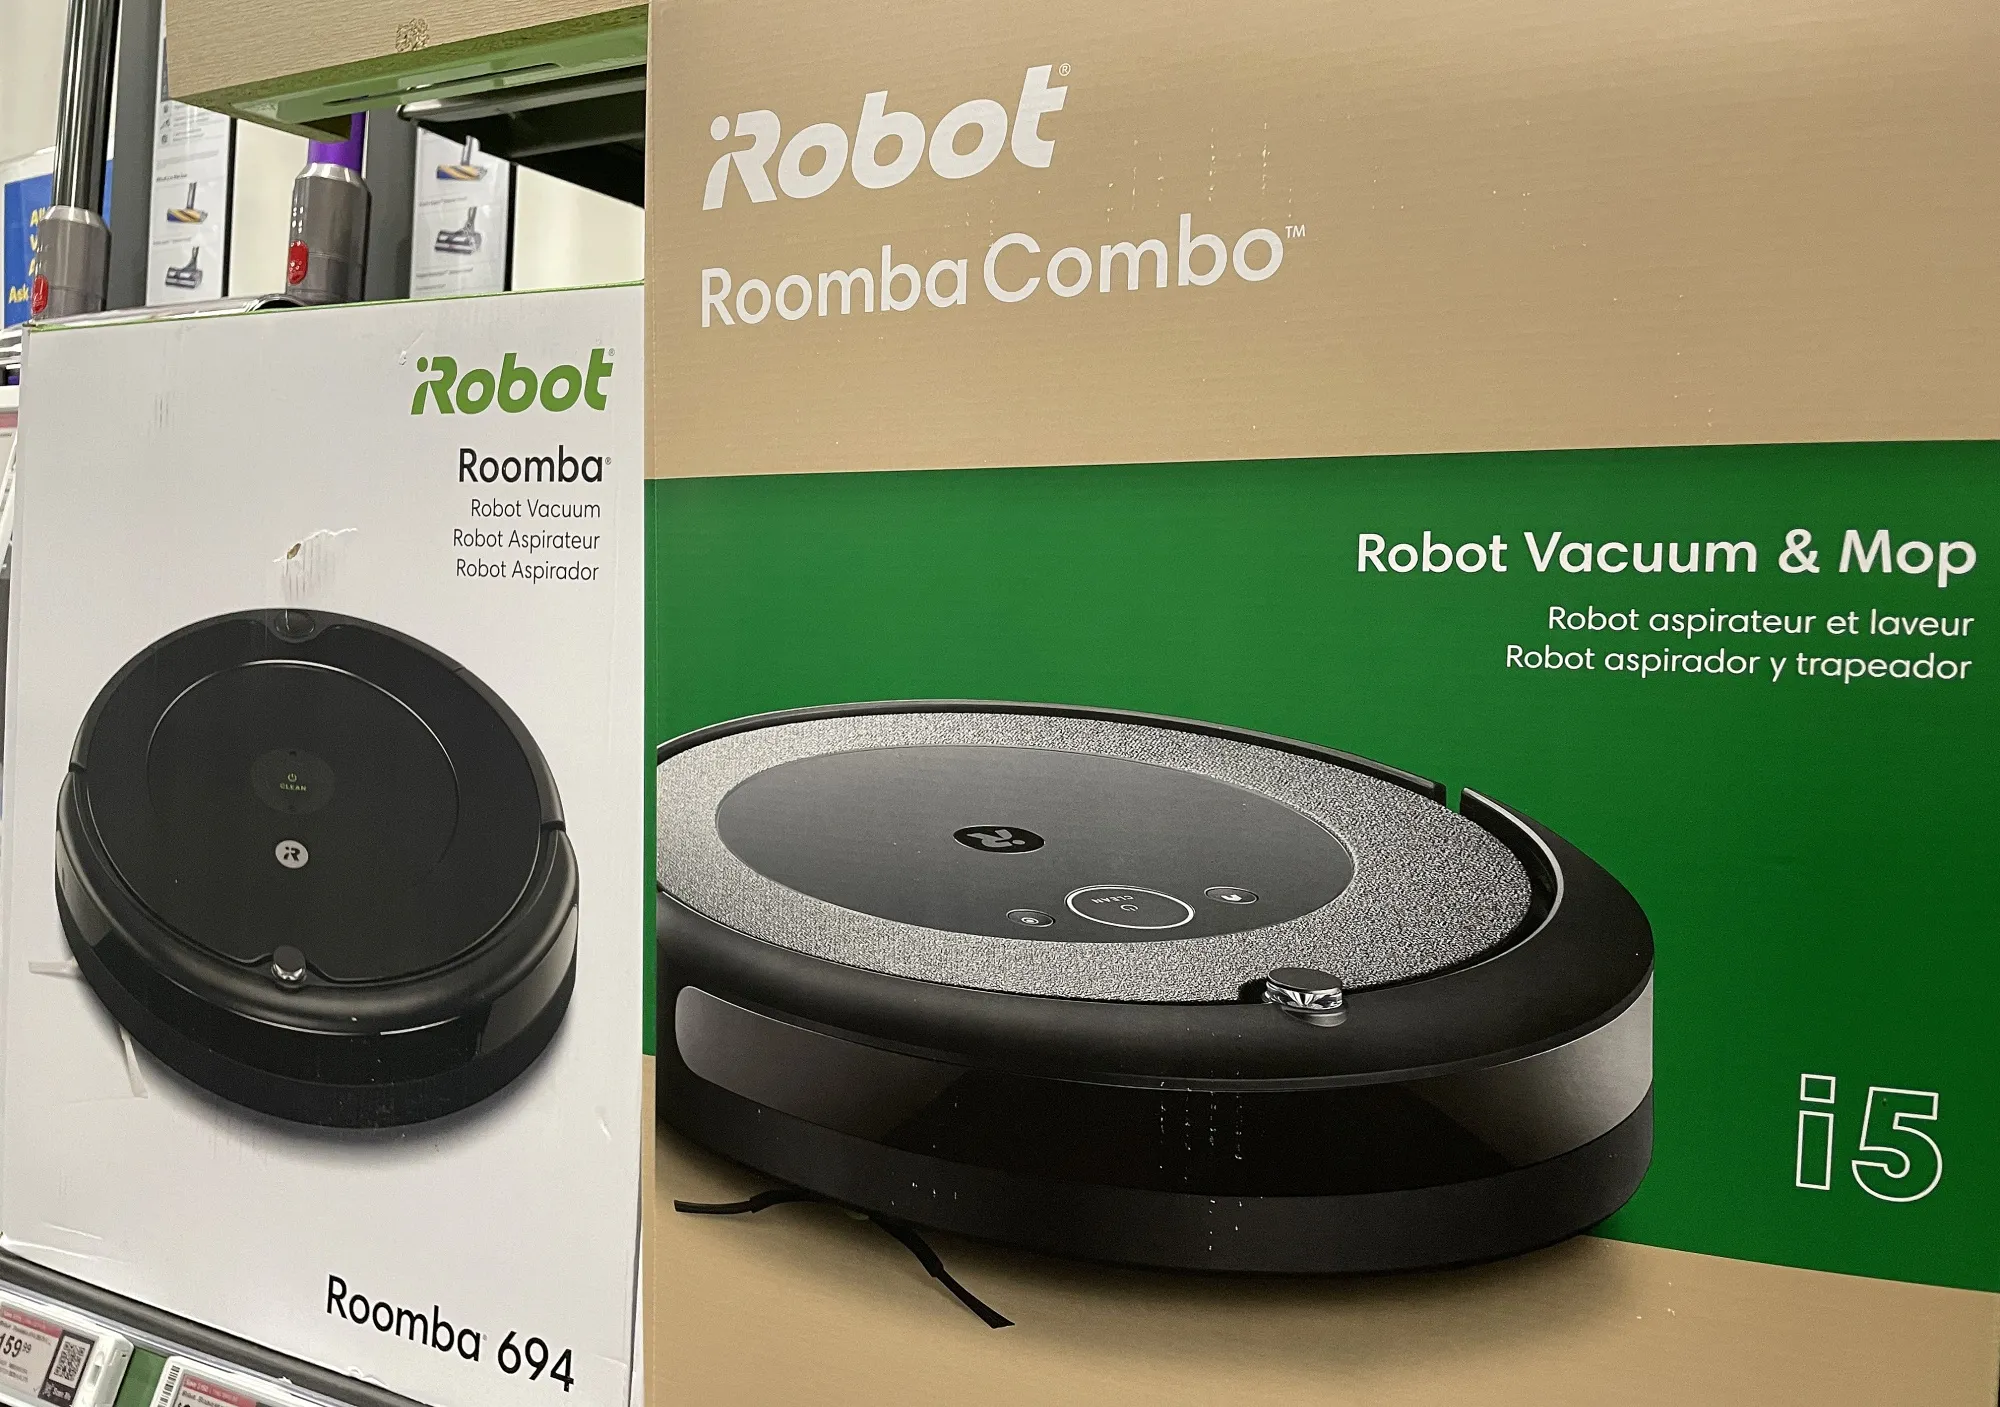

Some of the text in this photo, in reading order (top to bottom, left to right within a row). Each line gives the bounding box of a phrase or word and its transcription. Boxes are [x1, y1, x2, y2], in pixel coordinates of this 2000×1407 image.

[8, 285, 29, 304] Ask
[701, 245, 967, 328] Roomba
[471, 498, 601, 518] Robot Vacuum
[453, 528, 601, 554] Robot Aspirateur
[1357, 528, 1977, 588] Robot Vacuum & Mop
[456, 558, 600, 585] Robot Aspirador
[1548, 605, 1975, 640] Robot aspirateur et laveur
[1506, 644, 1973, 685] Robot aspirador y trapeador
[280, 782, 307, 792] CLEAN
[1795, 1073, 1943, 1203] i5
[326, 1274, 575, 1393] Roomba 694
